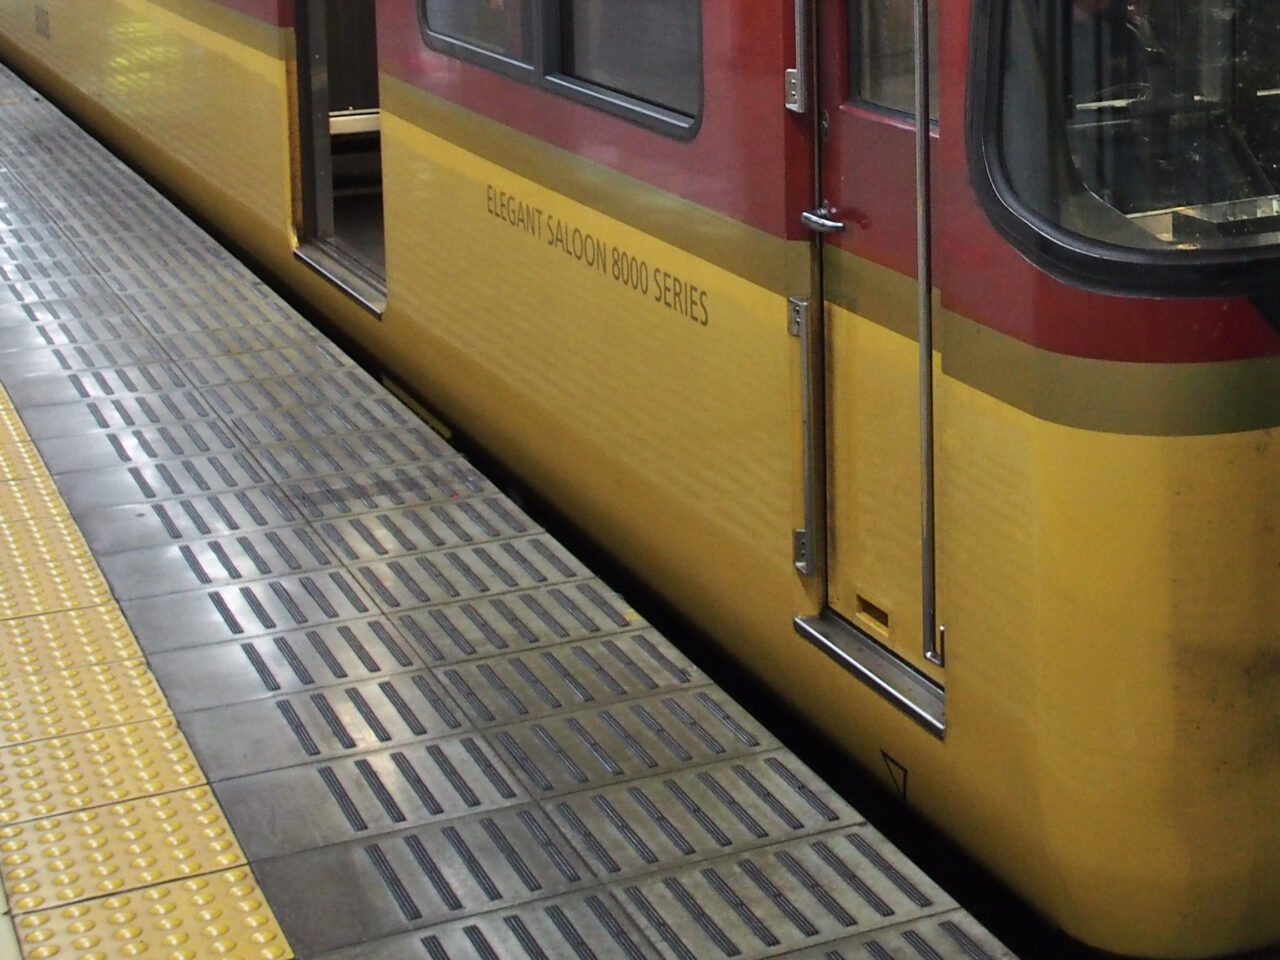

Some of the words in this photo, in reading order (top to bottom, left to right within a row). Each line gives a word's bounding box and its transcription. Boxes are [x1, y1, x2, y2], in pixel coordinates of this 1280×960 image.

[486, 184, 543, 240] ELEGANT
[547, 214, 607, 274] SALOON
[611, 247, 648, 294] 8000
[653, 267, 709, 327] SERIES
